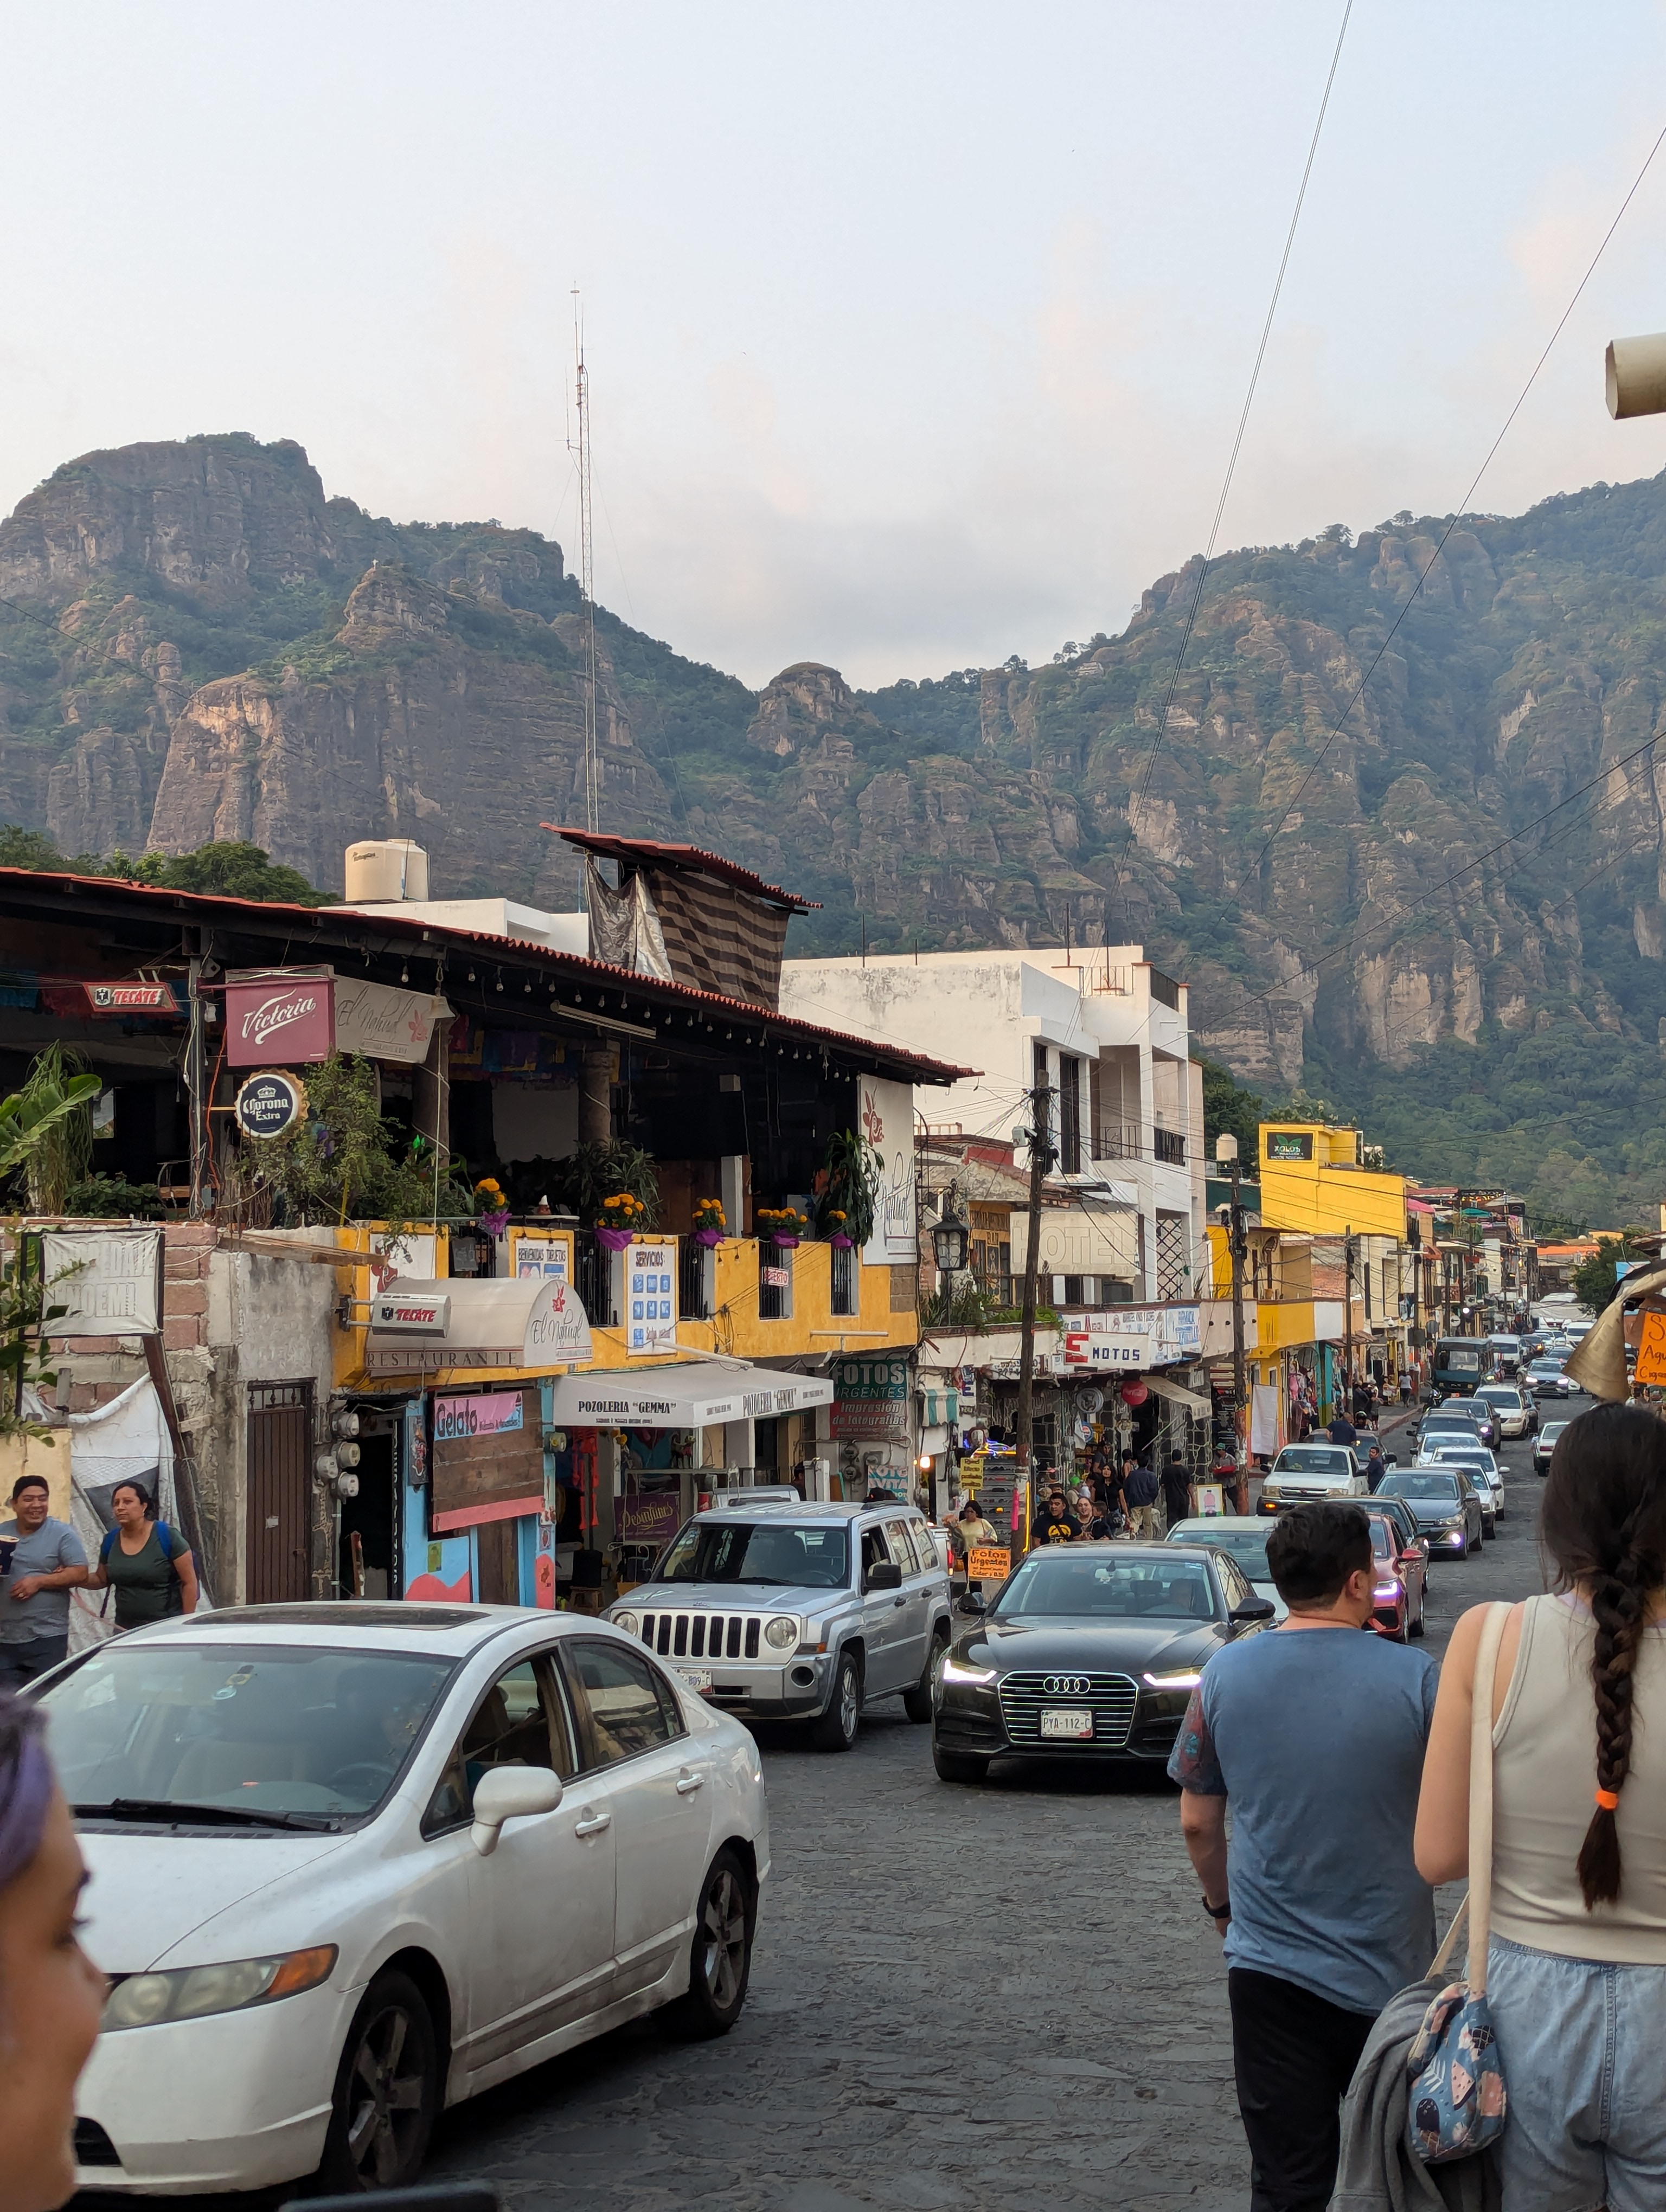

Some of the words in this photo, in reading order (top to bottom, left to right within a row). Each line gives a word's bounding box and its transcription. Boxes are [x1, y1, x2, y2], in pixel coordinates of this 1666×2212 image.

[112, 988, 161, 1005] TECATE
[336, 985, 370, 1026] El
[242, 988, 316, 1045] Victoria
[242, 1096, 290, 1115] Corona
[255, 1110, 281, 1122] Extra
[1012, 1226, 1134, 1264] HOTEL
[395, 1308, 437, 1322] TECATE
[530, 1310, 548, 1344] El
[367, 1351, 517, 1367] RESTAURANTE
[1092, 1347, 1140, 1361] MOTOS
[831, 1362, 905, 1385] FOTOS
[578, 1400, 629, 1413] POZOLERIA
[437, 1398, 478, 1437] Gelato
[1043, 1718, 1090, 1729] PYA-112-C
